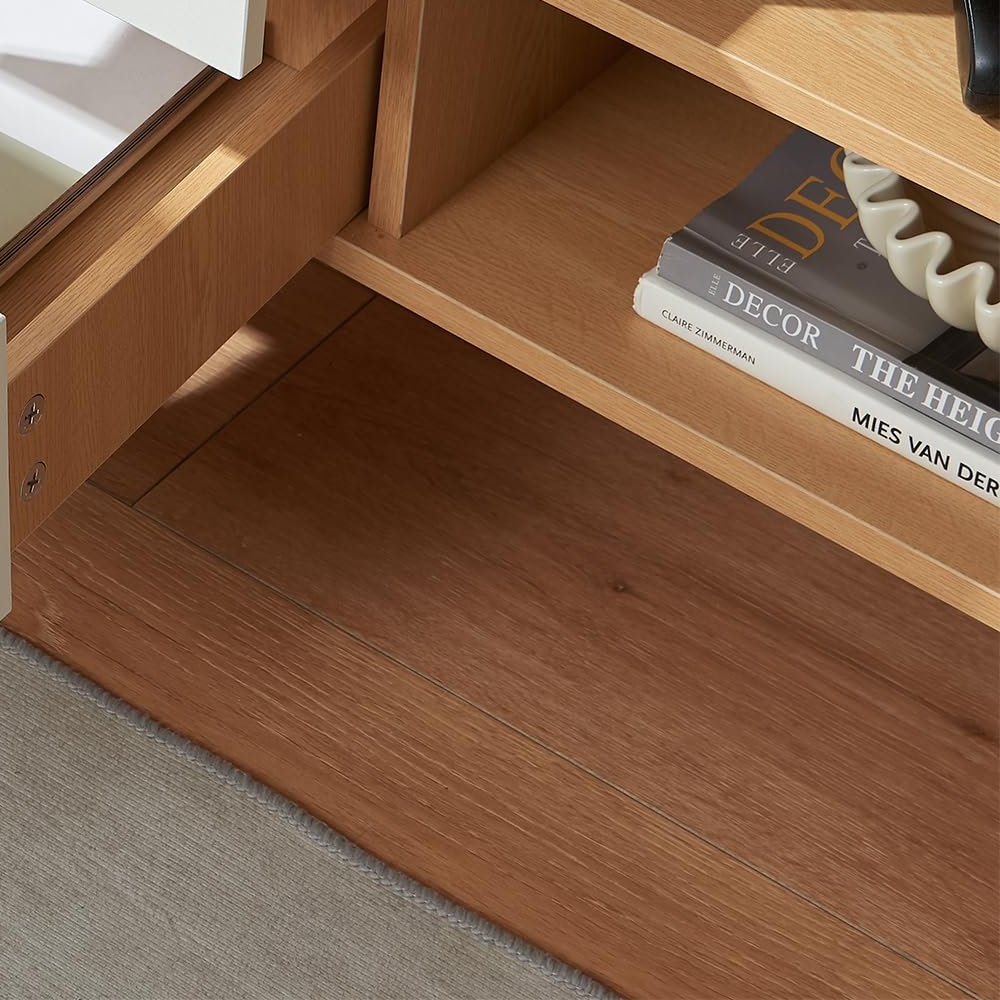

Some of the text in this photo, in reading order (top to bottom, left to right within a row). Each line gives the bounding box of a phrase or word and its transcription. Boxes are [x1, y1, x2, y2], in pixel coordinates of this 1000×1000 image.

[730, 233, 797, 275] ELLE
[708, 272, 721, 297] ELLE
[661, 309, 756, 365] CLAIRE ZIMMERMAN
[722, 281, 821, 350] DECOR
[851, 344, 919, 399] THE
[851, 407, 1000, 498] MIES VAN DER
